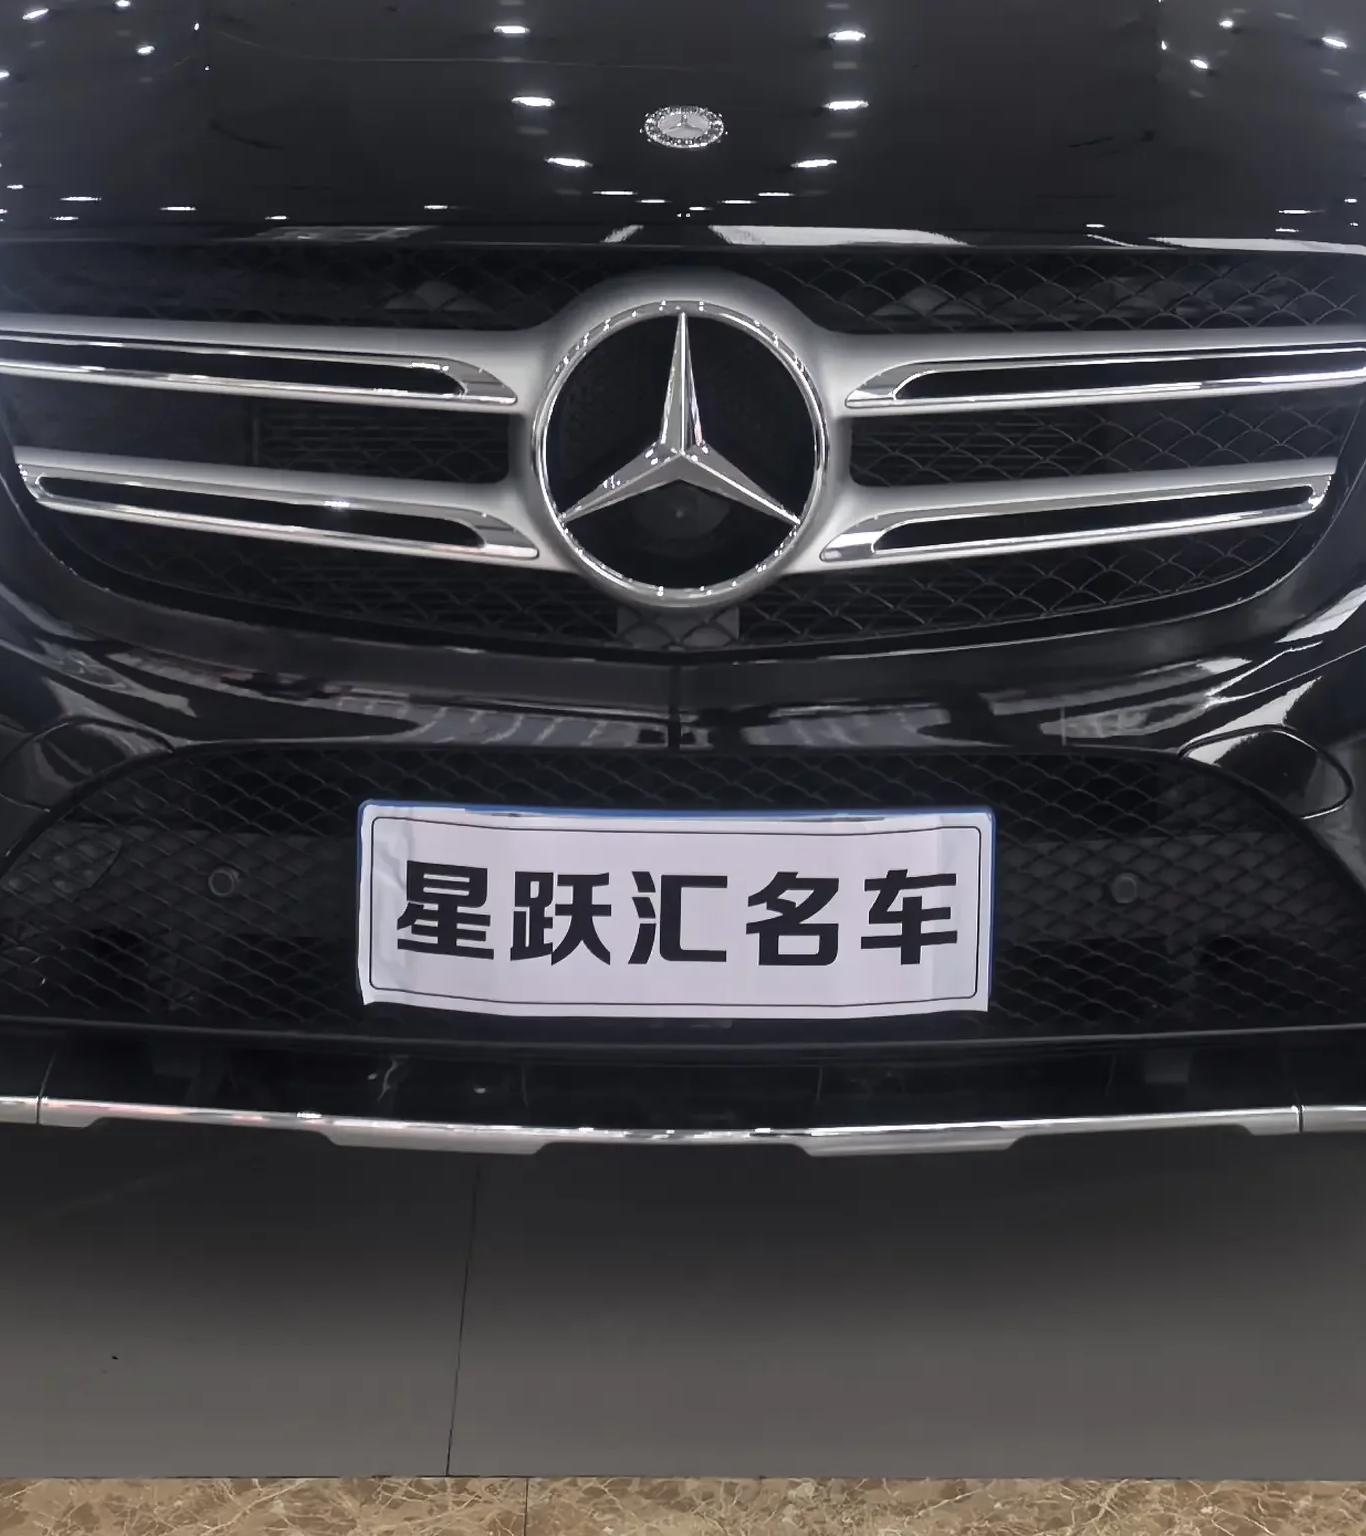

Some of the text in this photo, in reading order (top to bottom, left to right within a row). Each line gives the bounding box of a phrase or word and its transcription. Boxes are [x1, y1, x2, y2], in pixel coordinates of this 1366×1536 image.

[396, 859, 959, 967] 星跃汇名车
